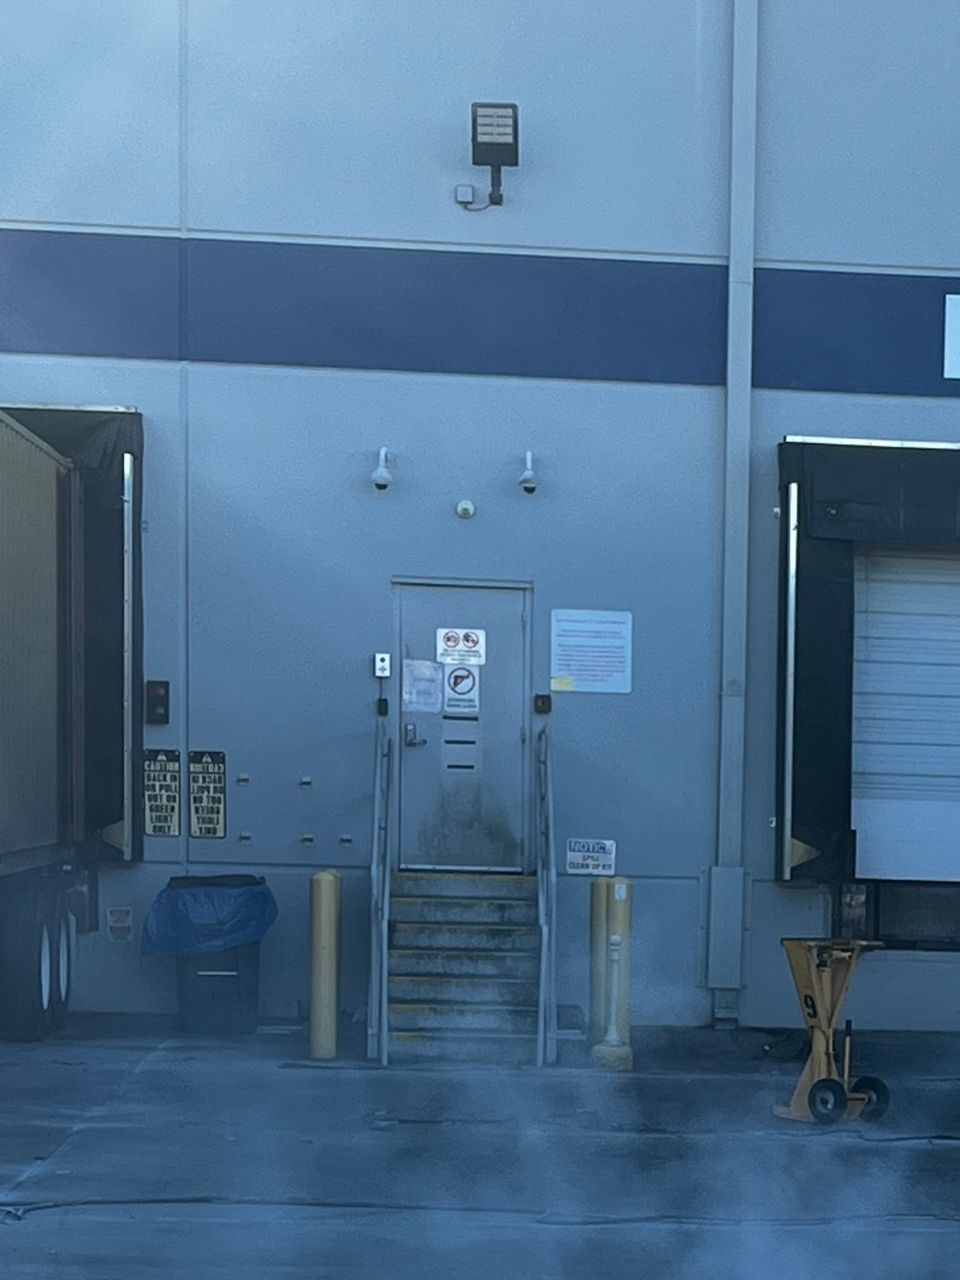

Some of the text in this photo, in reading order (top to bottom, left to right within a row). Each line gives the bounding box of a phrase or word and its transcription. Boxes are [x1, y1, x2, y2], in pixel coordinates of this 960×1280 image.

[144, 761, 179, 771] CAUTION
[146, 773, 178, 782] BACK IN
[144, 783, 178, 793] OR PULL
[147, 794, 177, 803] OUT ON
[149, 804, 175, 813] GREEN
[150, 814, 173, 824] LIGHT
[152, 825, 171, 834] ONLY
[803, 993, 819, 1019] 9
